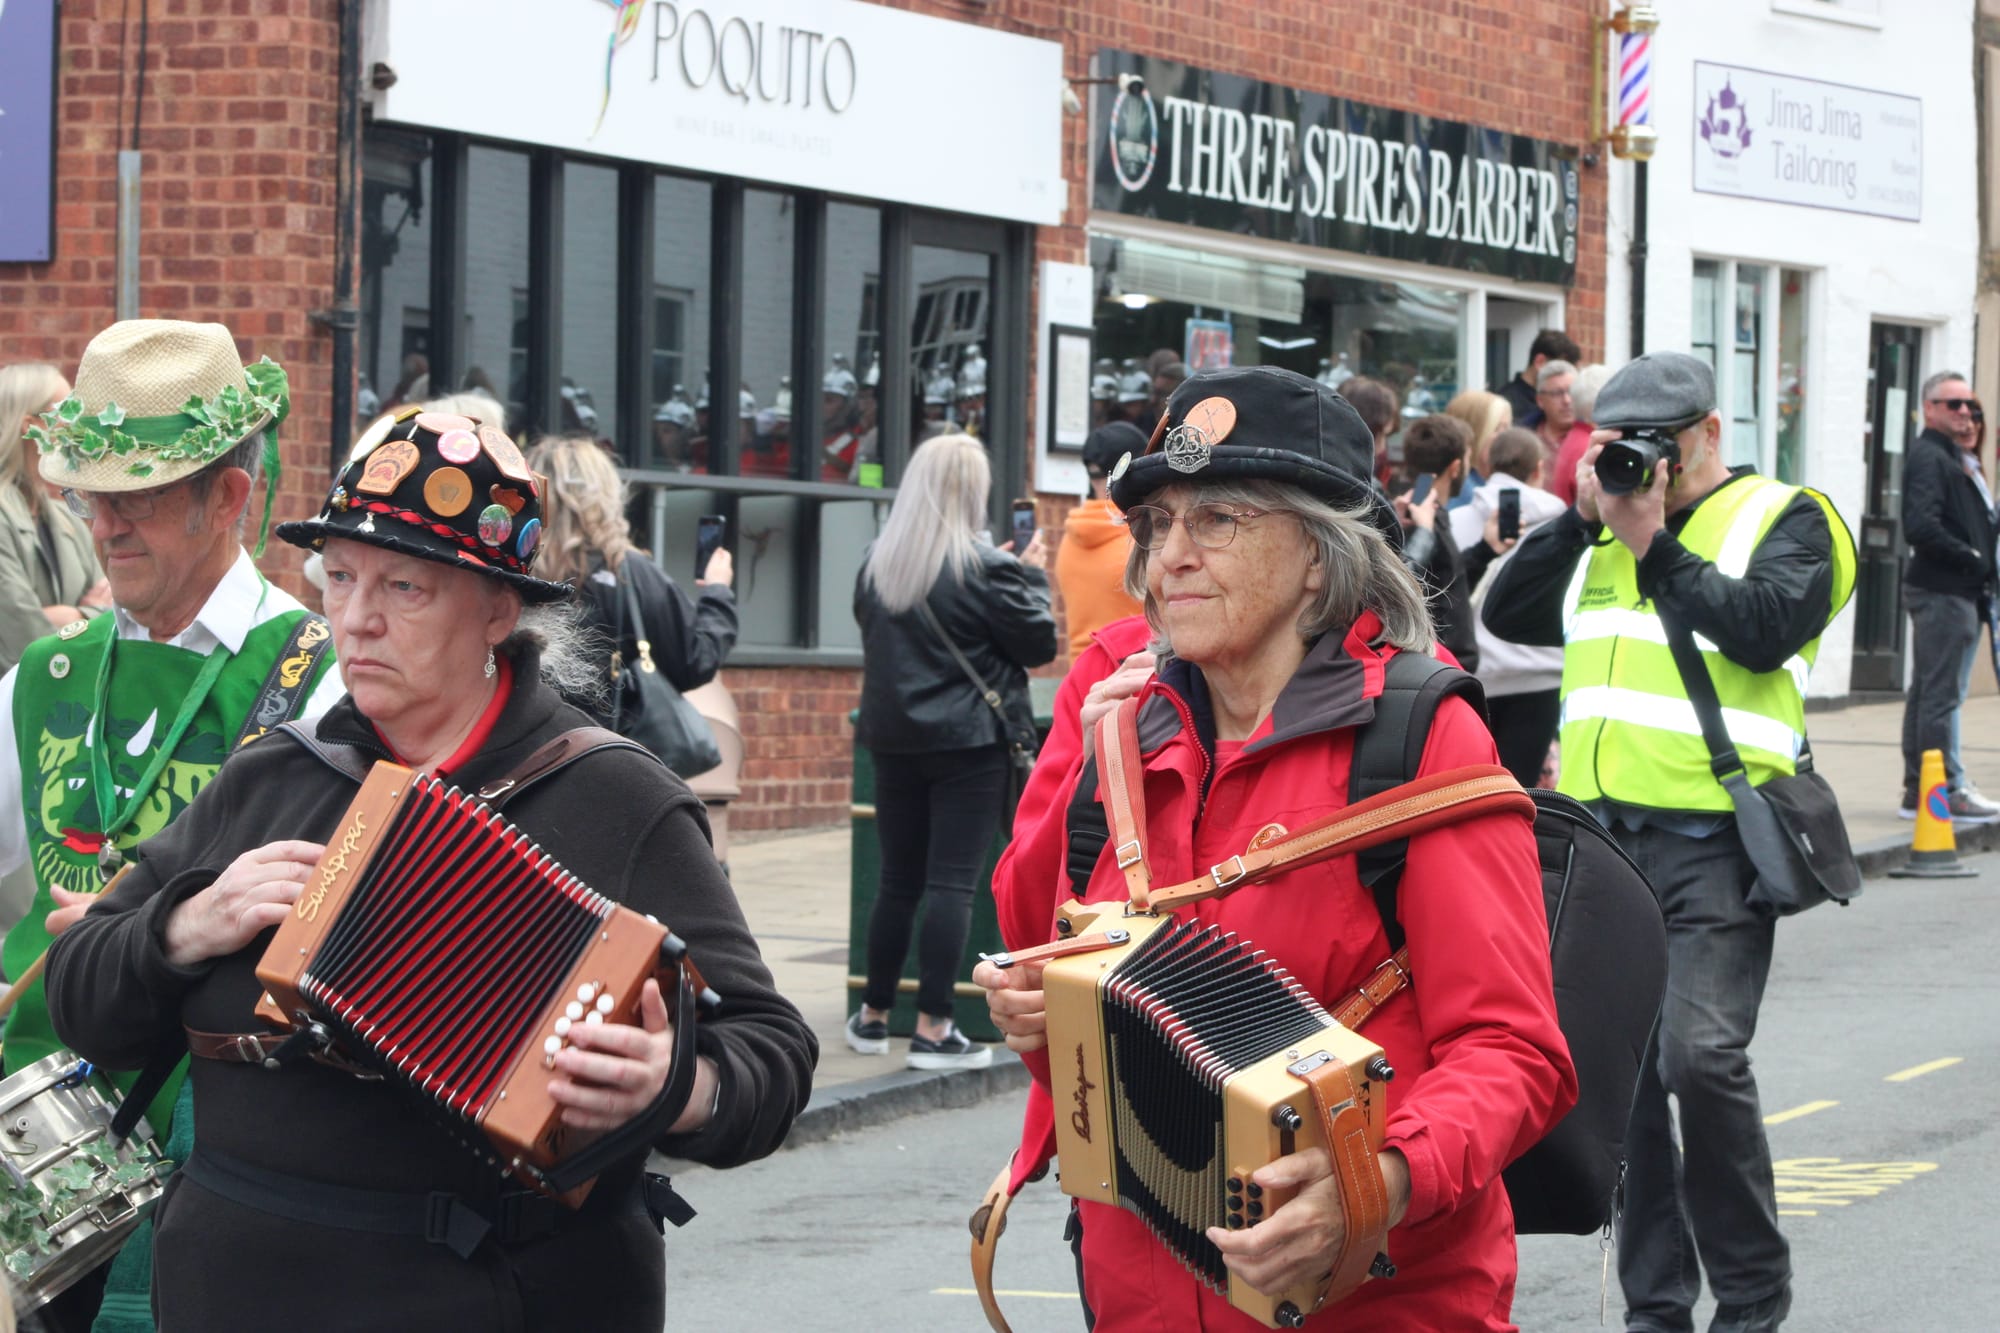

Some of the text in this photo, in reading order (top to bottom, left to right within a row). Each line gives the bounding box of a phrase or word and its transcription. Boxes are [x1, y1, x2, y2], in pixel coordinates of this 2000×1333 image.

[650, 1, 857, 114] POQUITO
[1766, 87, 1813, 132] Jima
[1818, 96, 1862, 140] Jima
[1163, 95, 1294, 212] THREE
[1301, 123, 1422, 234] SPIRES
[1427, 149, 1561, 257] BARBER
[1770, 140, 1858, 200] Tailoring
